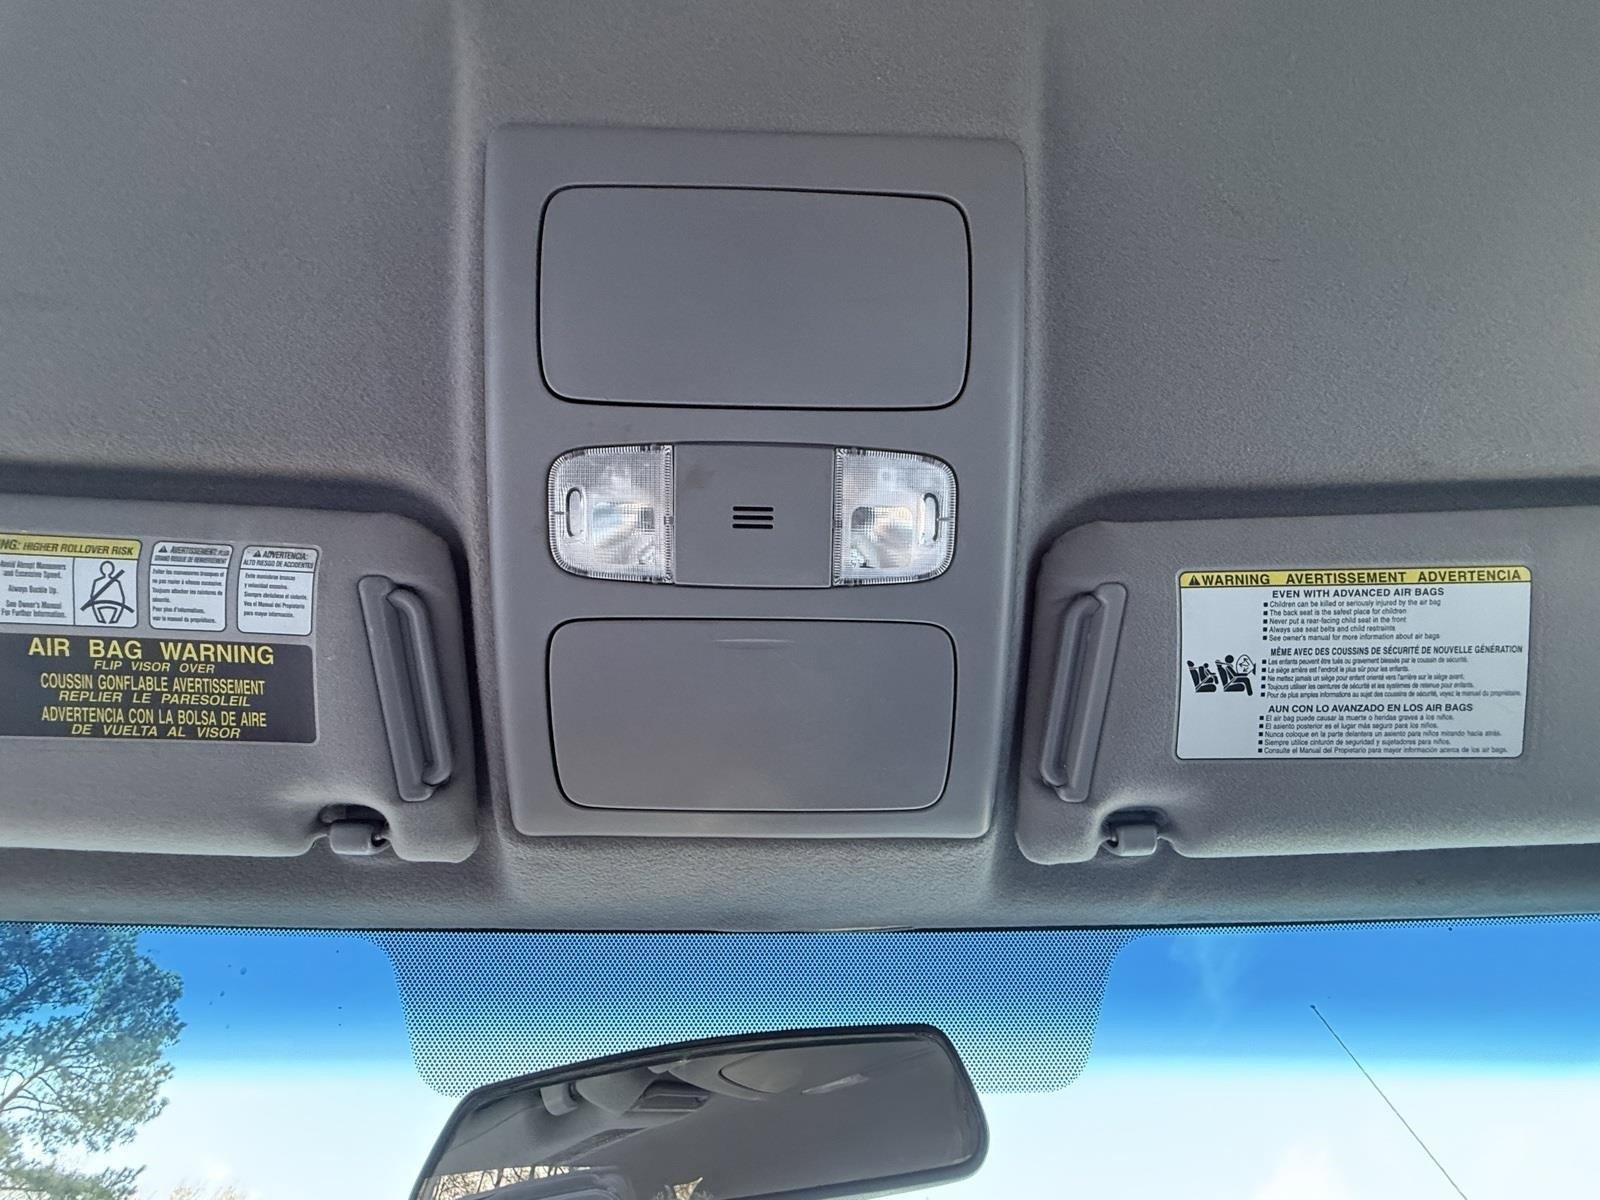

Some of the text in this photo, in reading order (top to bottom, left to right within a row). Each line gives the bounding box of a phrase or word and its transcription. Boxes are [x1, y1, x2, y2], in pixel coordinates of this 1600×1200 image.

[23, 542, 58, 552] HIGHER
[60, 543, 109, 555] ROLLOVER
[111, 546, 134, 555] RISK
[1202, 570, 1522, 585] WARNING AVERTISSEMENT ADVERTENCIA
[1272, 588, 1444, 598] EVEN WITH ADVANCED AIR BAGS
[1346, 600, 1374, 608] seriously
[1375, 600, 1397, 608] injured
[1398, 599, 1406, 607] by
[1429, 599, 1441, 607] bag
[1353, 608, 1370, 616] place
[1289, 617, 1299, 625] put
[1306, 617, 1340, 625] rear-facing
[1269, 626, 1291, 634] Always
[1424, 632, 1440, 640] bags
[28, 637, 274, 665] AIR BAG WARNING
[1270, 646, 1292, 656] MÊME
[1332, 647, 1369, 655] COUSSINS
[1383, 645, 1420, 654] SÉCURITÉ
[1475, 645, 1523, 653] GÉNÉRATION
[93, 660, 215, 674] FLIP VISOR OVER
[40, 672, 265, 695] COUSSIN GONFLABLE AVERTISSEMENT
[58, 690, 251, 707] REPLIER LE PARESOLEIL
[41, 706, 267, 727] ADVERTENCIA CON LA BOLSA DE AIRE
[71, 723, 241, 739] DE VUELTA AL VISOR
